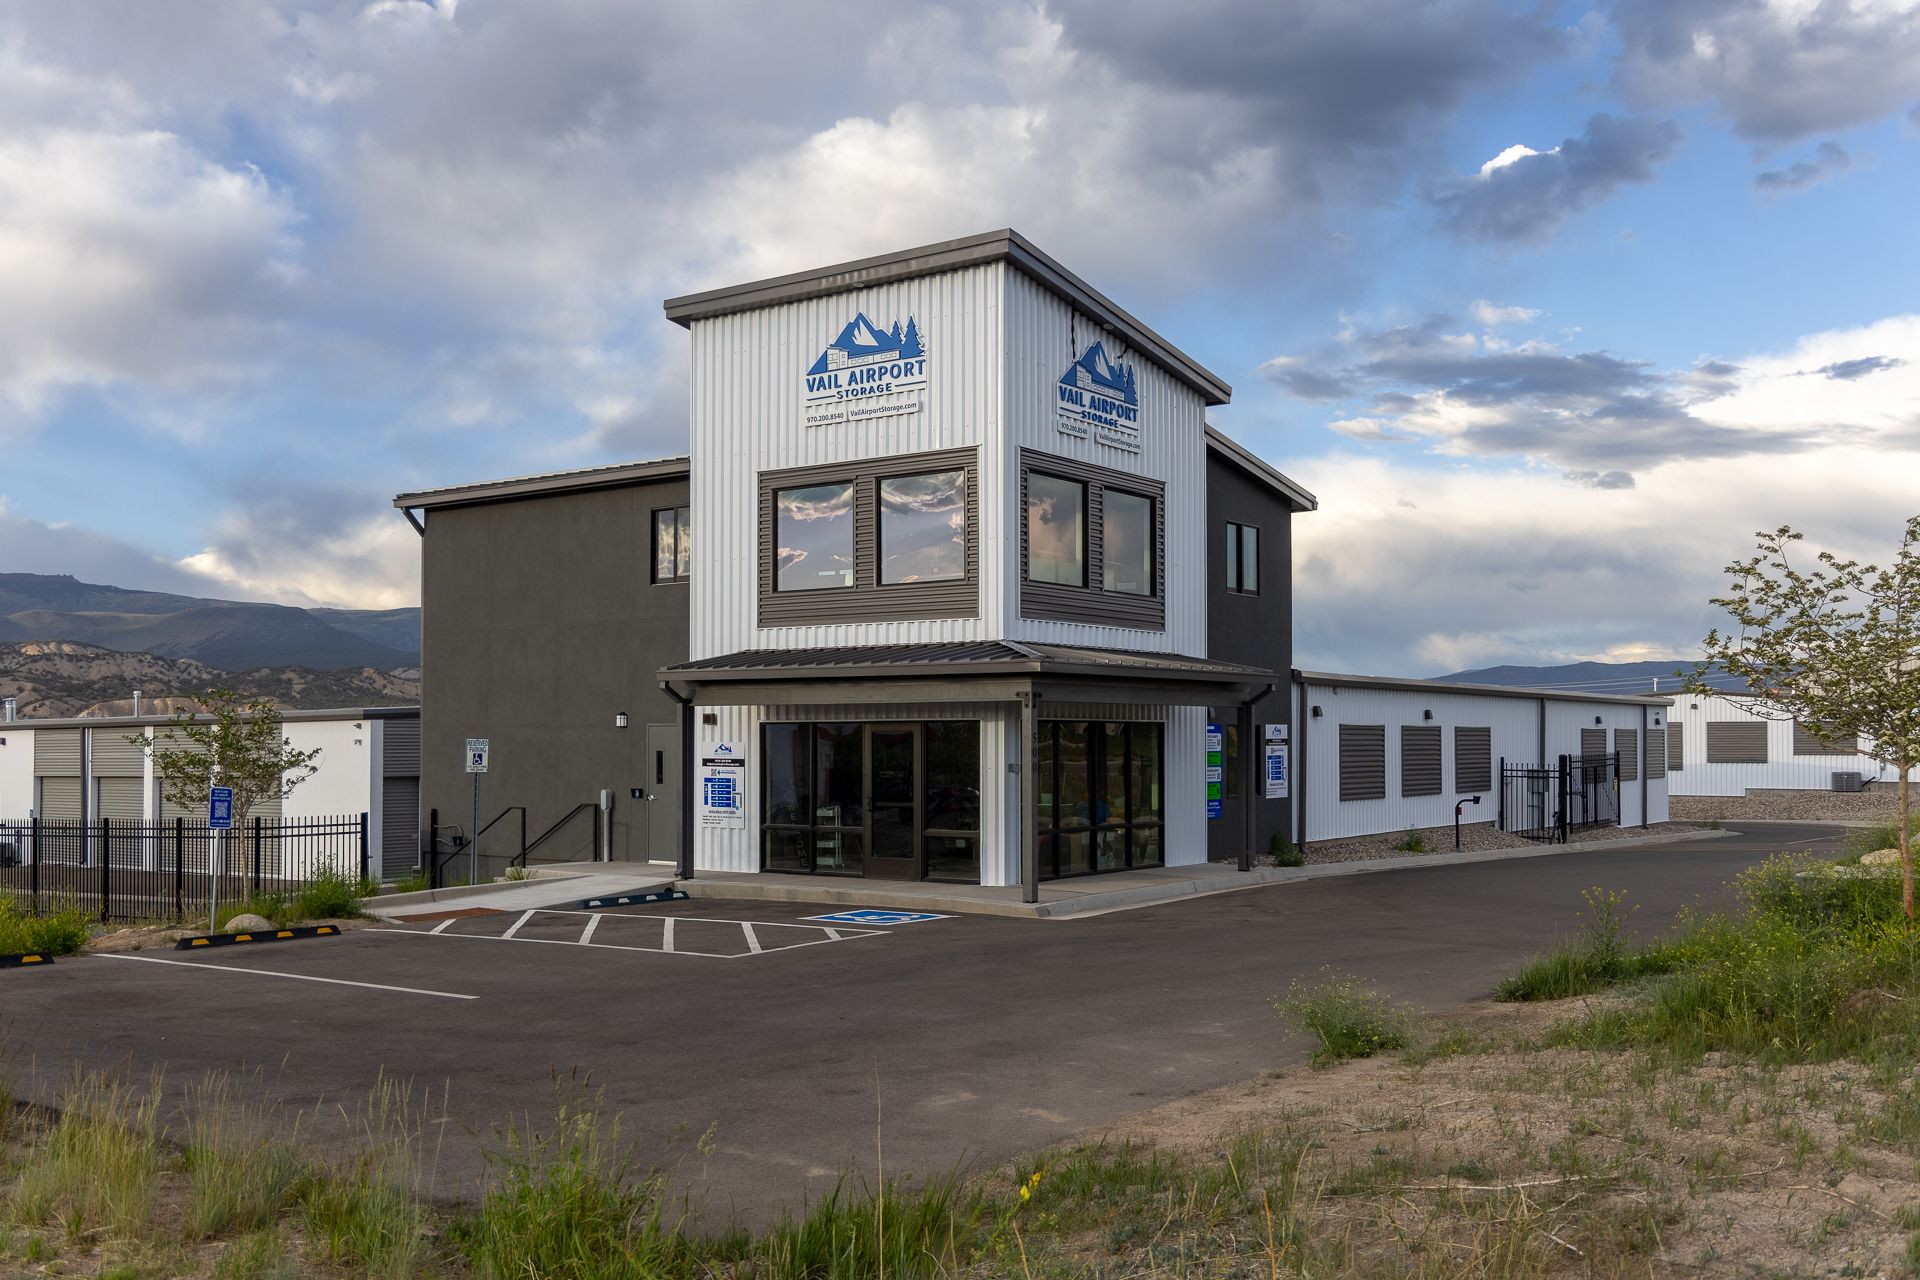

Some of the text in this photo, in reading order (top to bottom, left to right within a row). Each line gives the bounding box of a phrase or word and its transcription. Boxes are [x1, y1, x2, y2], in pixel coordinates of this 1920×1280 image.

[806, 359, 926, 392] VAIL AIRPORT
[836, 382, 893, 400] STORAGE
[850, 402, 917, 417] VailAirportStorage.com
[1058, 385, 1139, 422] VAIL AIRPORT
[806, 412, 844, 423] 970.200.8540
[1081, 410, 1120, 429] STORAGE
